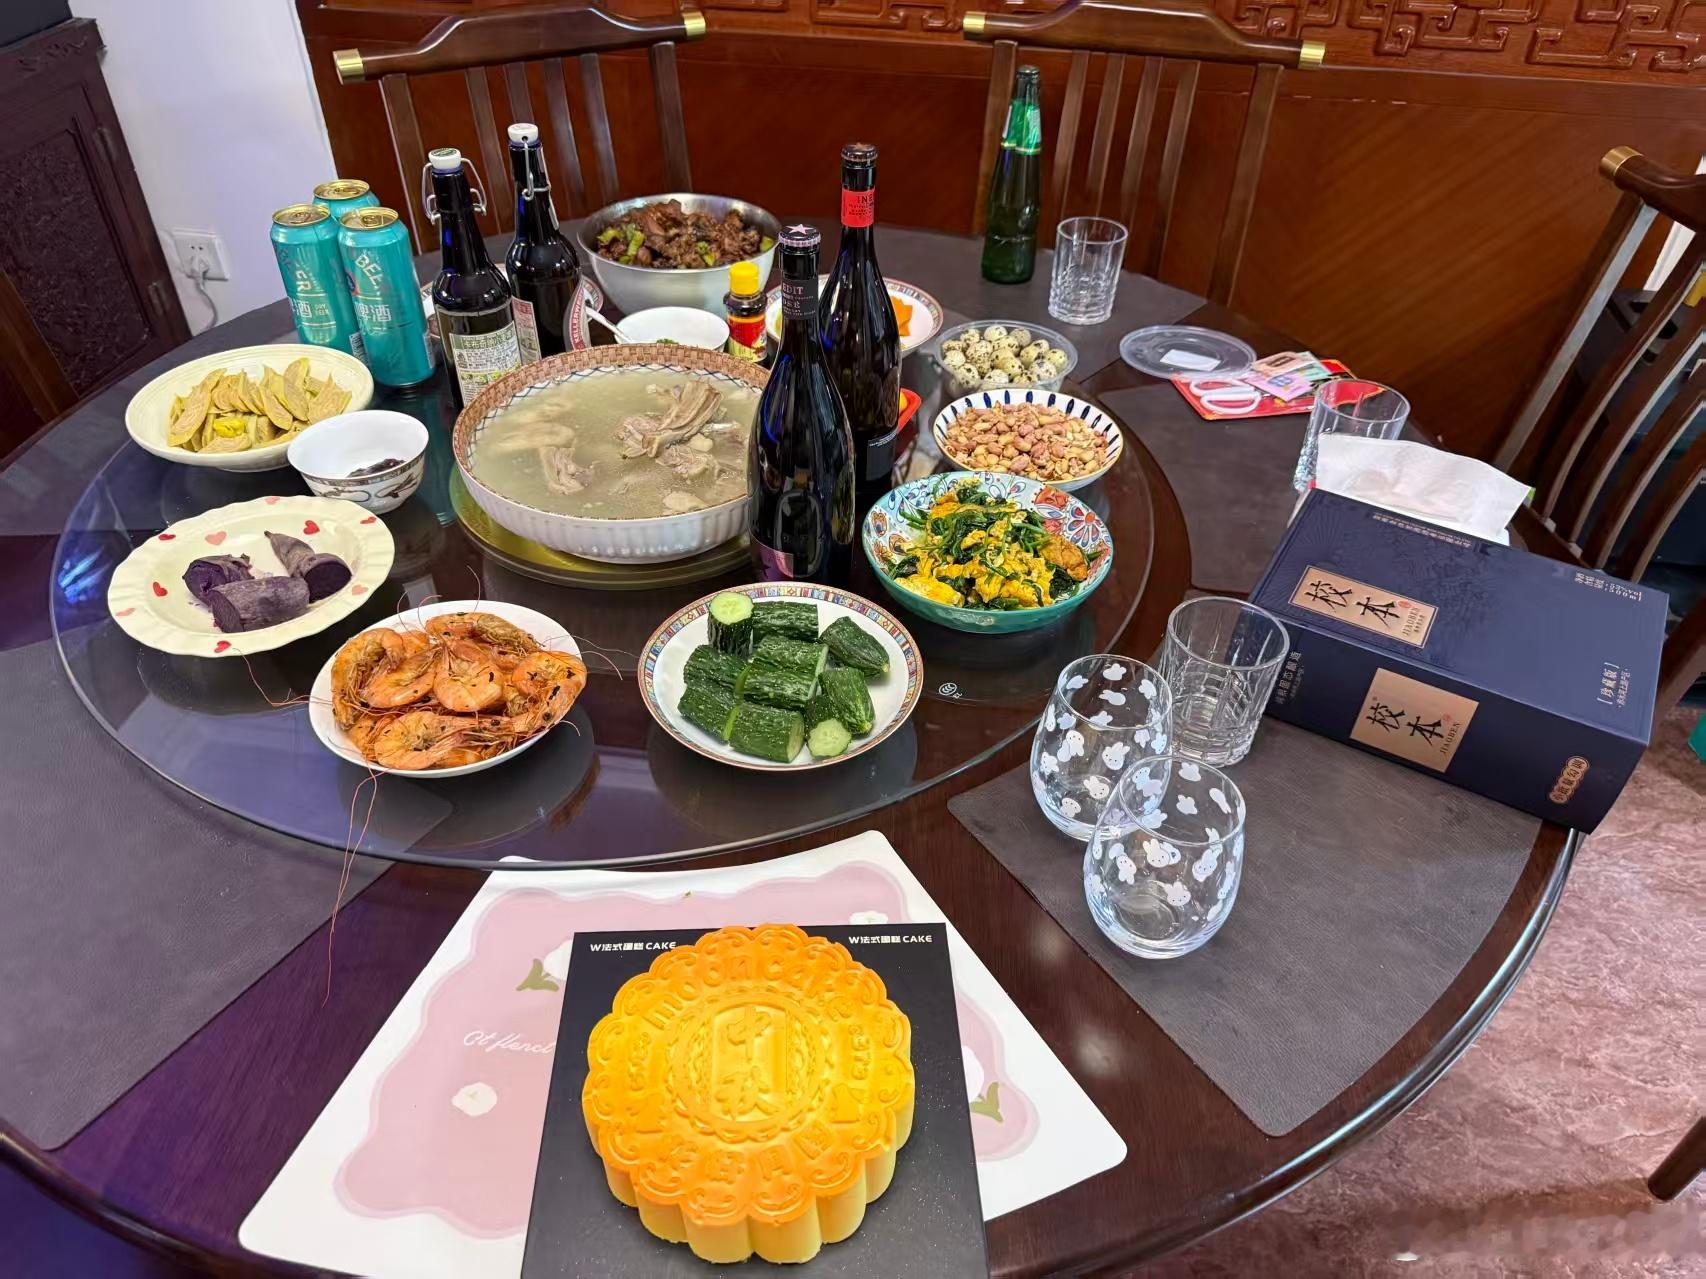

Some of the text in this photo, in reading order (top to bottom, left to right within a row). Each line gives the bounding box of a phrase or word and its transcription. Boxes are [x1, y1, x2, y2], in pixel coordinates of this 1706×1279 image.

[1305, 580, 1401, 629] 校本
[1366, 702, 1444, 747] 校本
[1440, 722, 1461, 754] JIAOBEN
[645, 941, 677, 950] CAKE
[902, 934, 933, 943] CAKE
